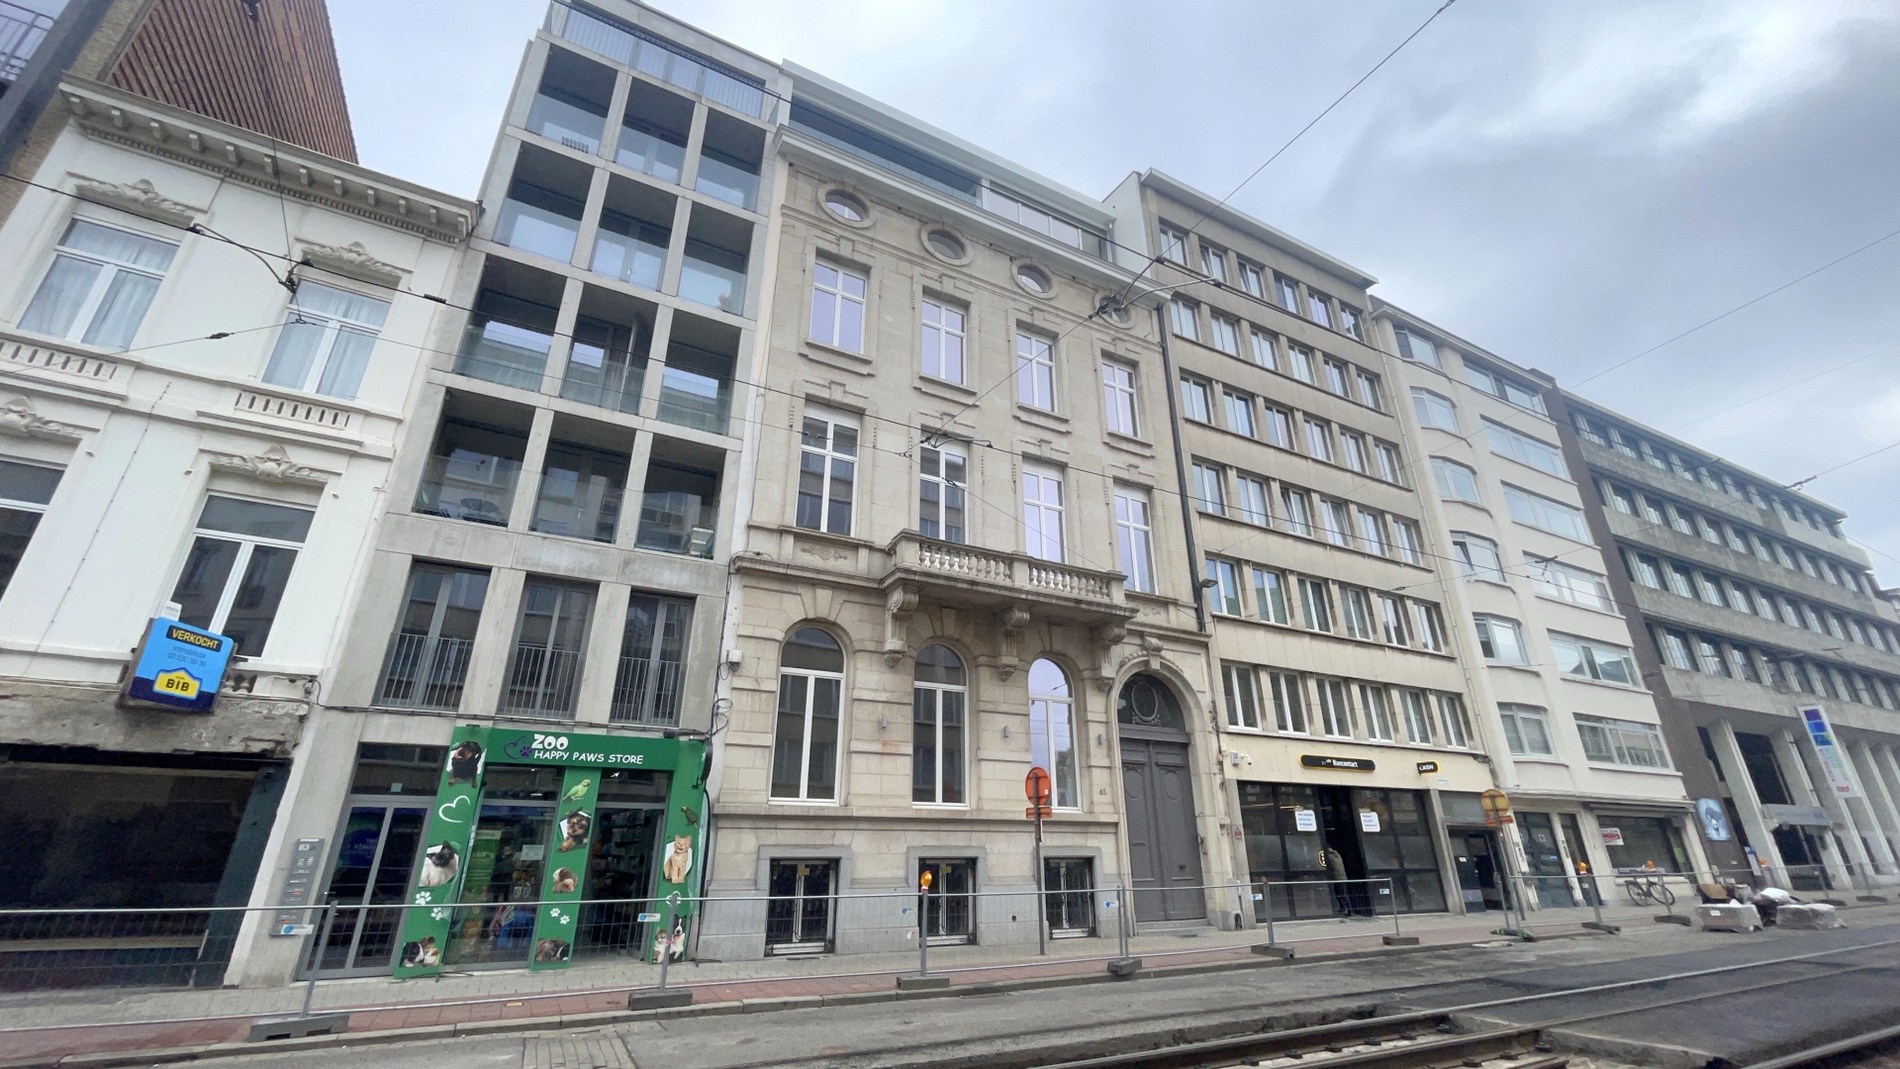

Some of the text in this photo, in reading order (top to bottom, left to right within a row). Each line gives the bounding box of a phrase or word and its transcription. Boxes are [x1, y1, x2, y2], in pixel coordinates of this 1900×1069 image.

[172, 628, 219, 650] VERKOCHT
[165, 678, 190, 692] BIB
[531, 733, 569, 750] ZOO
[533, 750, 644, 765] HAPPY PAWS STORE
[298, 843, 311, 851] 63
